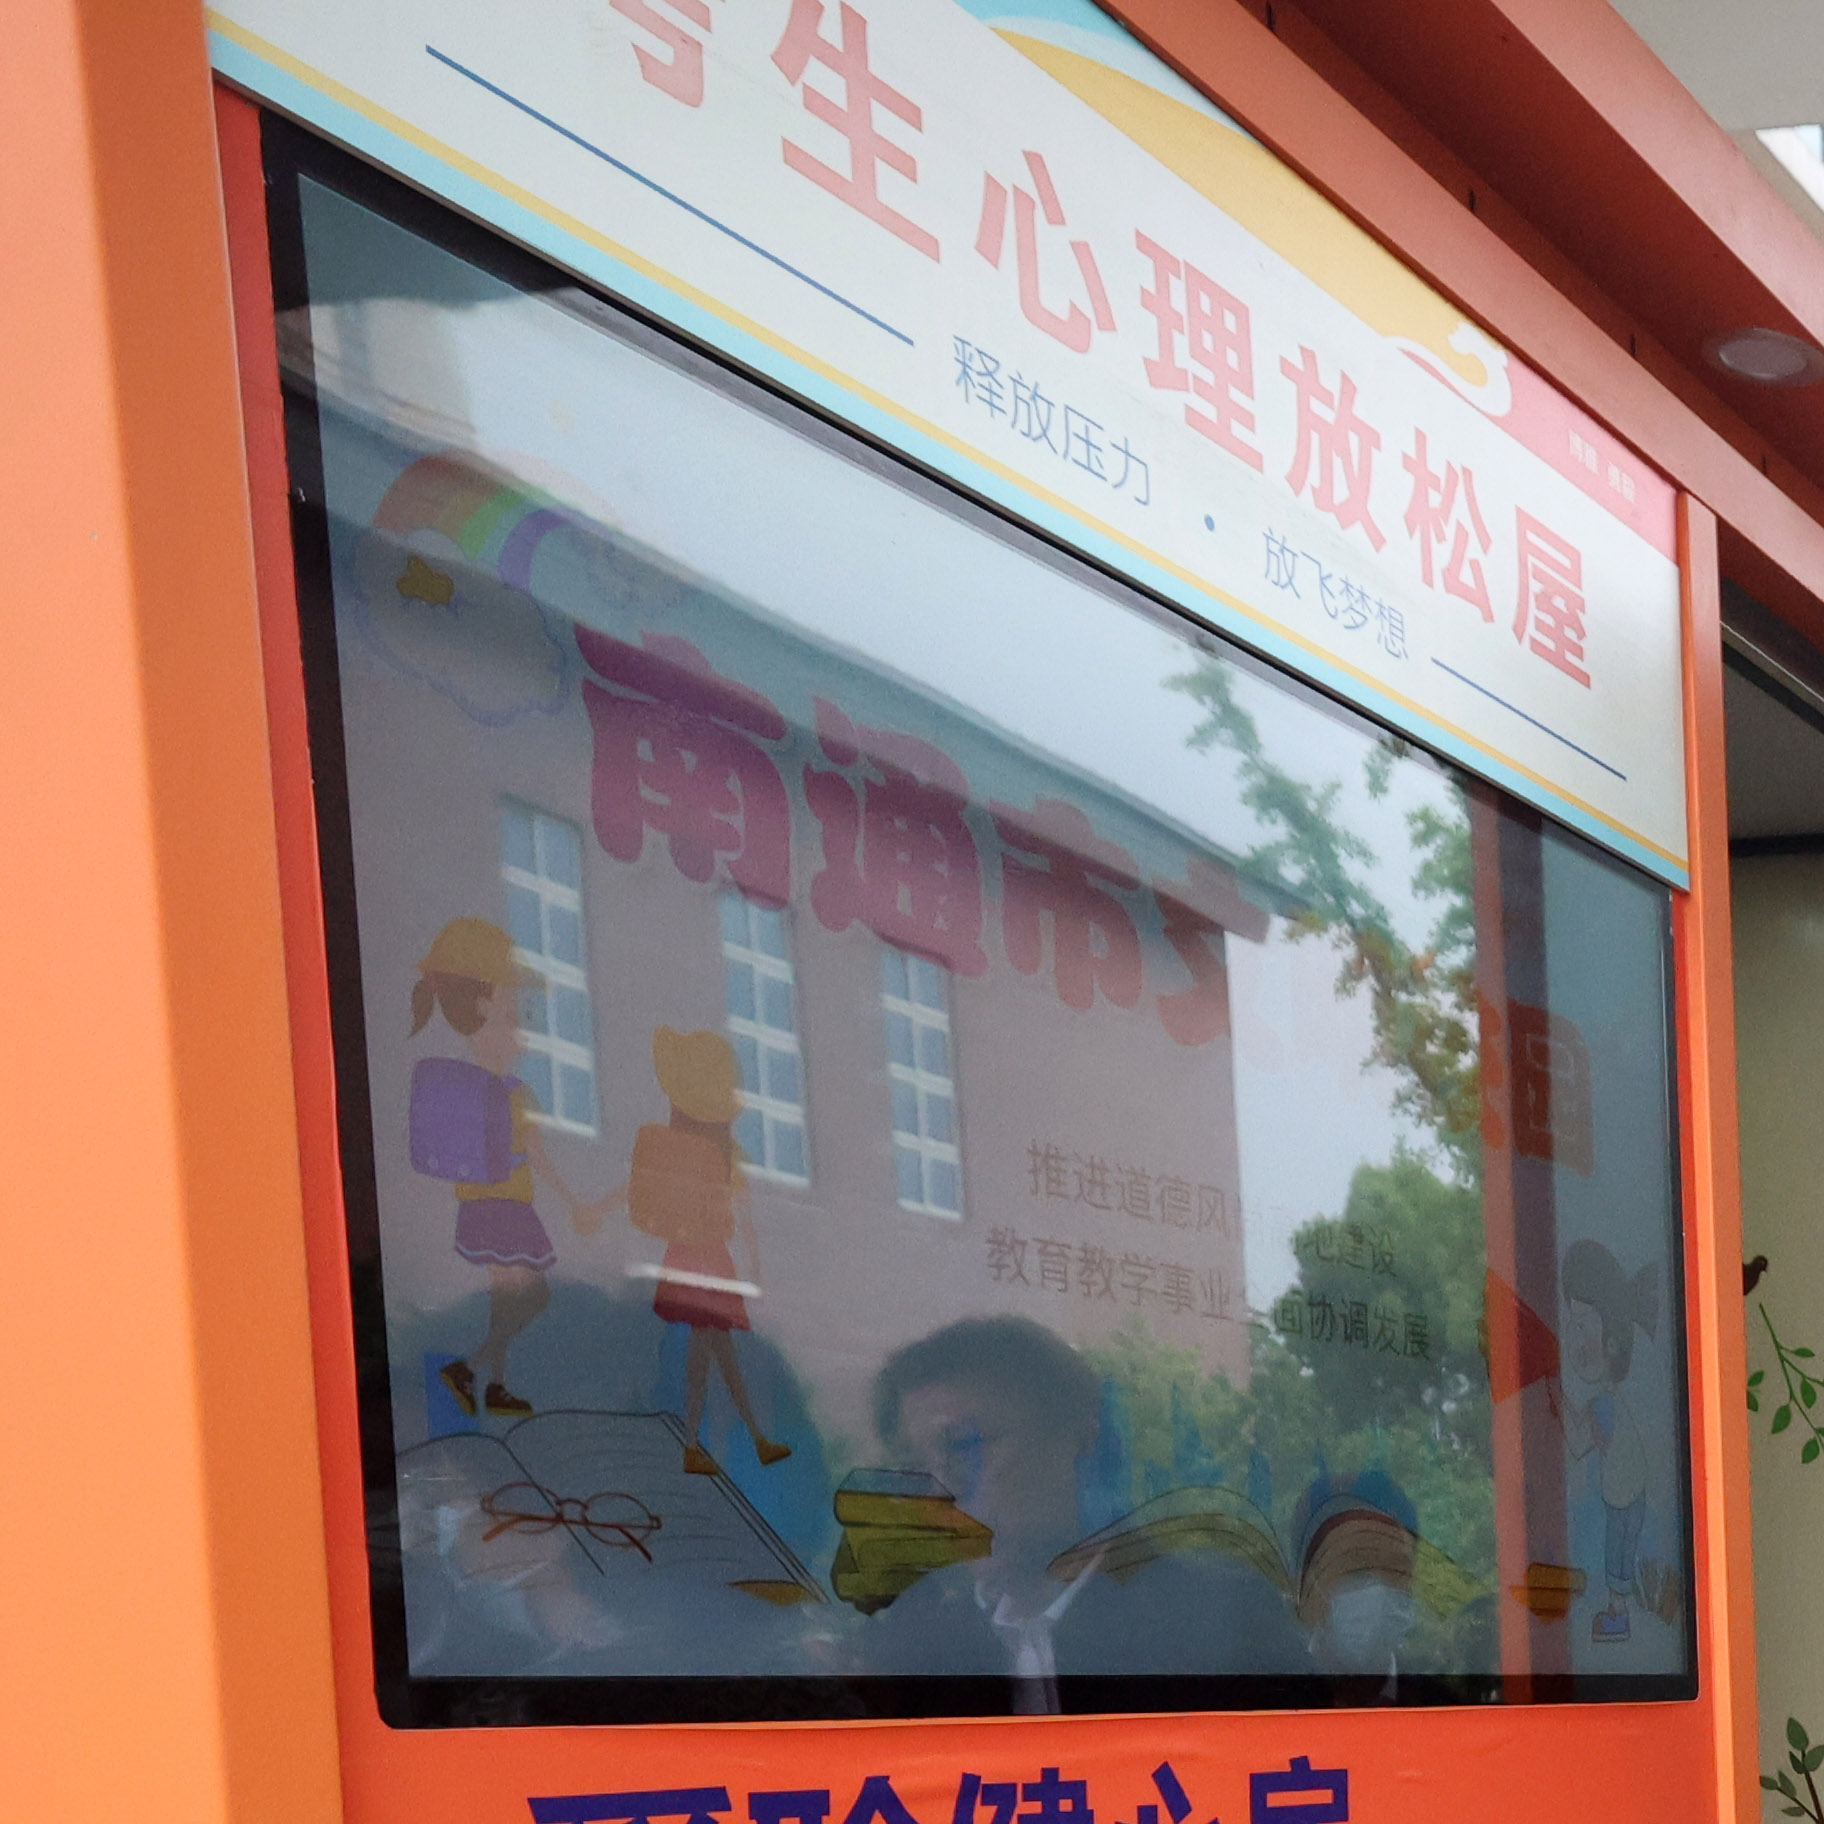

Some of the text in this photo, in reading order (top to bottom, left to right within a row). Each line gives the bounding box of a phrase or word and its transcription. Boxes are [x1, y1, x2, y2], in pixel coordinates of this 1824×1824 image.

[952, 334, 1409, 660] 释放压力 放飞梦想
